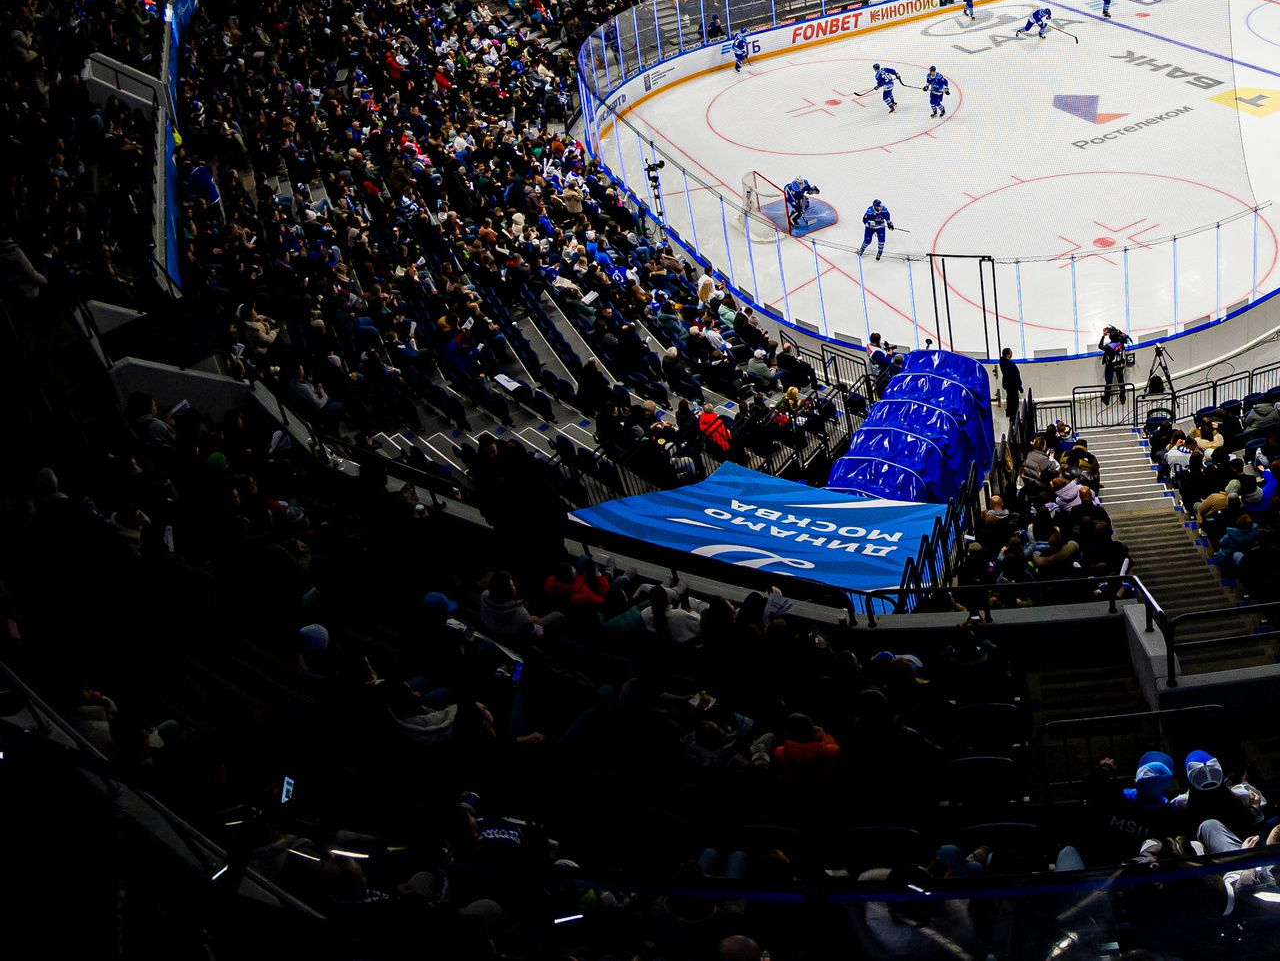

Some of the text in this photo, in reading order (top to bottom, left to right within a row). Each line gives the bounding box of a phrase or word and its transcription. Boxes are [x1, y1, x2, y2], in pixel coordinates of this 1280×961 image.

[792, 12, 862, 44] FONBET
[1110, 49, 1225, 90] БАНК
[1071, 105, 1194, 150] Ростелеком
[703, 507, 899, 558] ДИНАМО
[730, 498, 903, 543] МОСКВА
